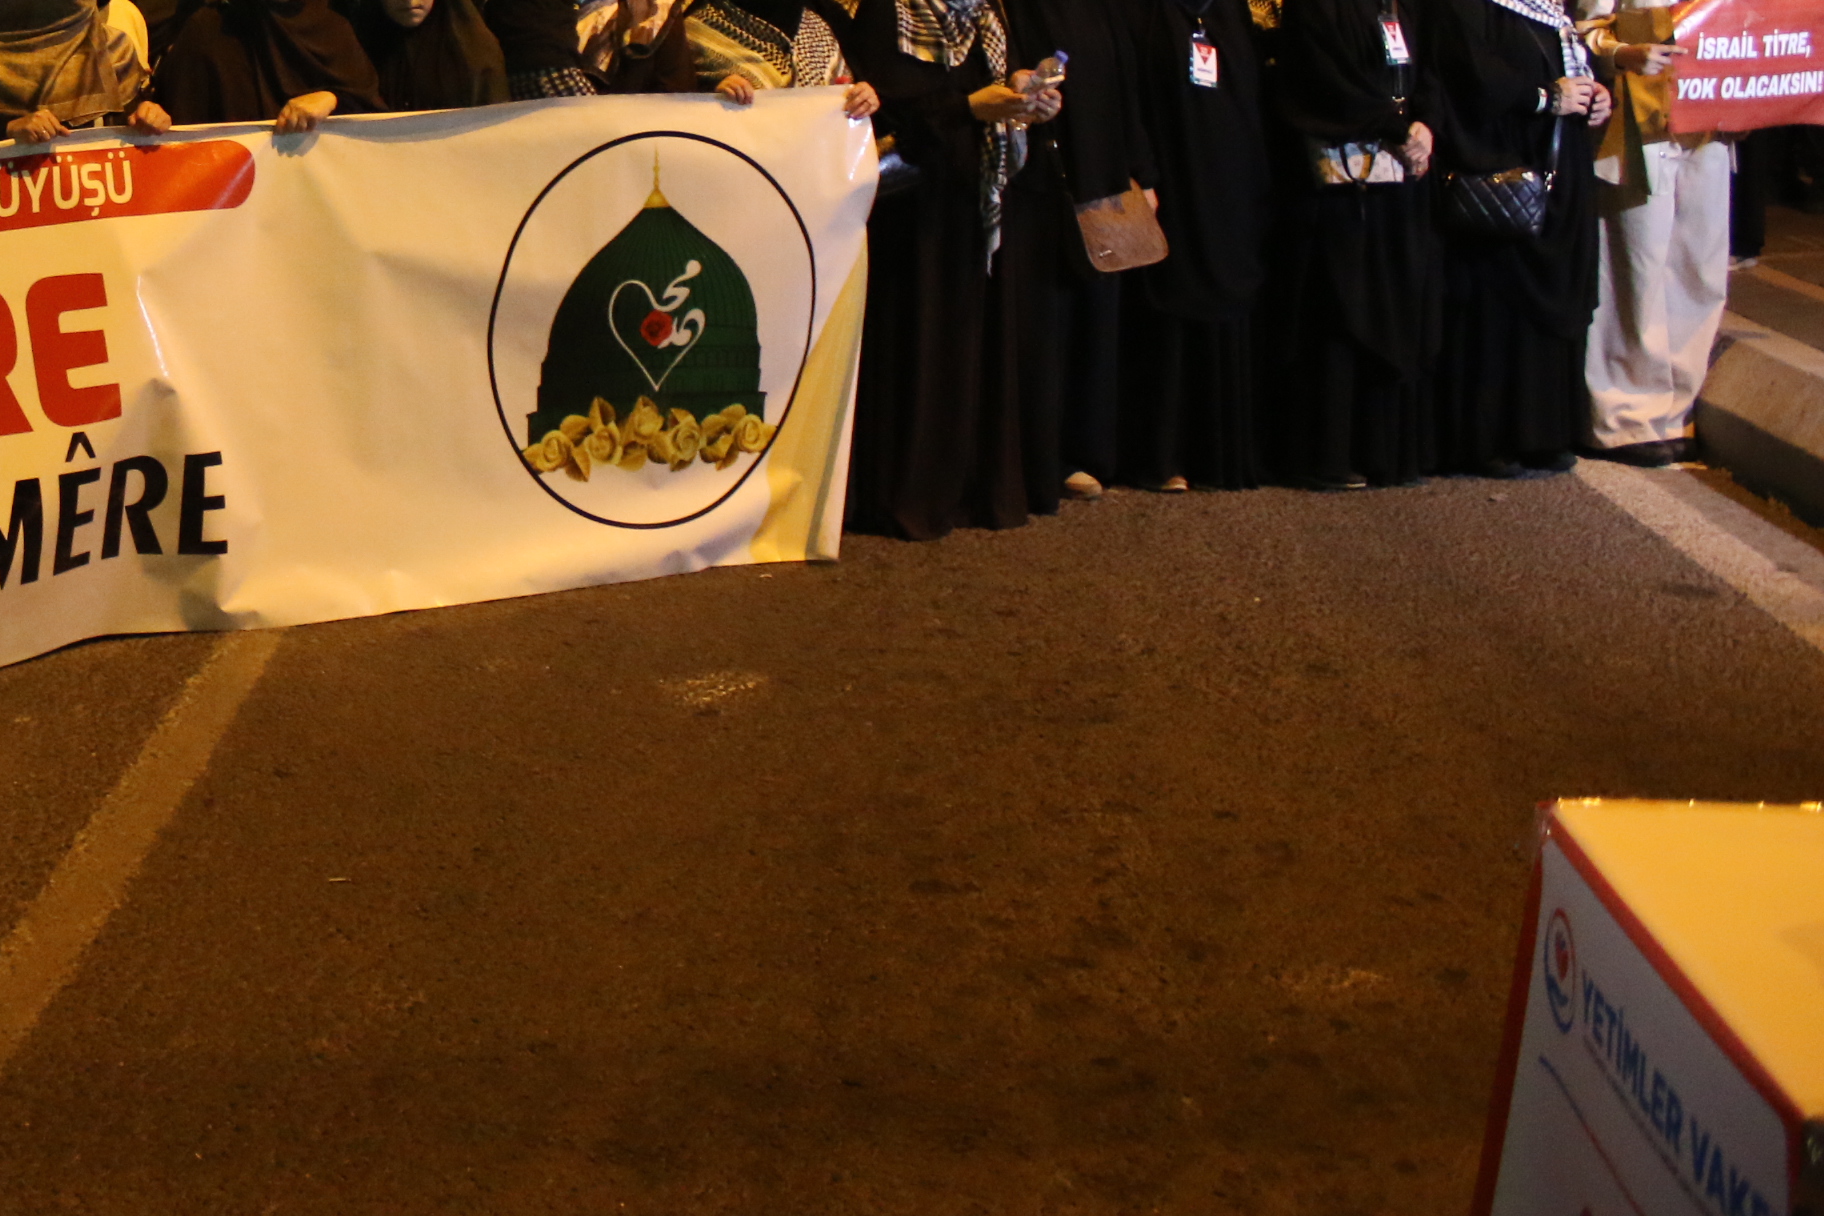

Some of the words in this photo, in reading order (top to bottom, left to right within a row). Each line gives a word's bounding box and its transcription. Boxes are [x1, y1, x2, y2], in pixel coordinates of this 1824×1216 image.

[1696, 30, 1758, 60] İSRAİL
[1763, 29, 1811, 59] TİTRE,
[1677, 77, 1718, 100] YOK
[1720, 70, 1824, 99] OLACAKSIN!
[1580, 967, 1685, 1154] YETİMLER
